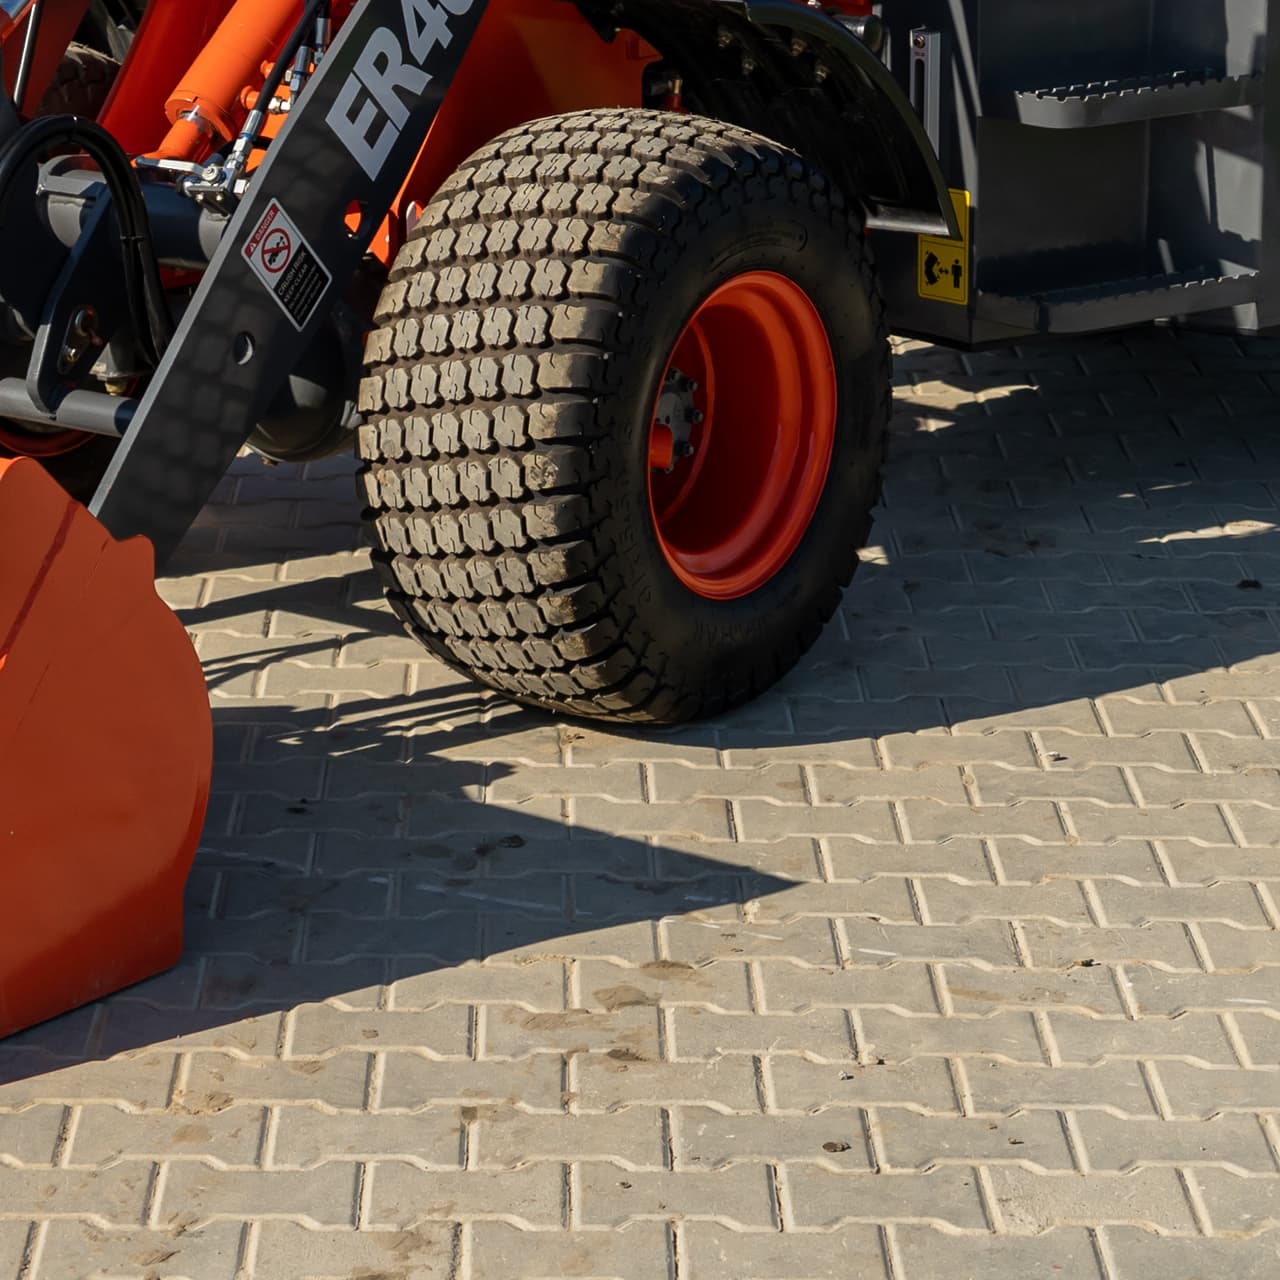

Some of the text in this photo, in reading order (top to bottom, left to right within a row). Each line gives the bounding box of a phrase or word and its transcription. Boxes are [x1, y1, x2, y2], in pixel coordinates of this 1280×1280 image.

[254, 209, 276, 241] DANGER
[278, 269, 296, 296] CRUSH
[293, 263, 308, 285] CLEAR
